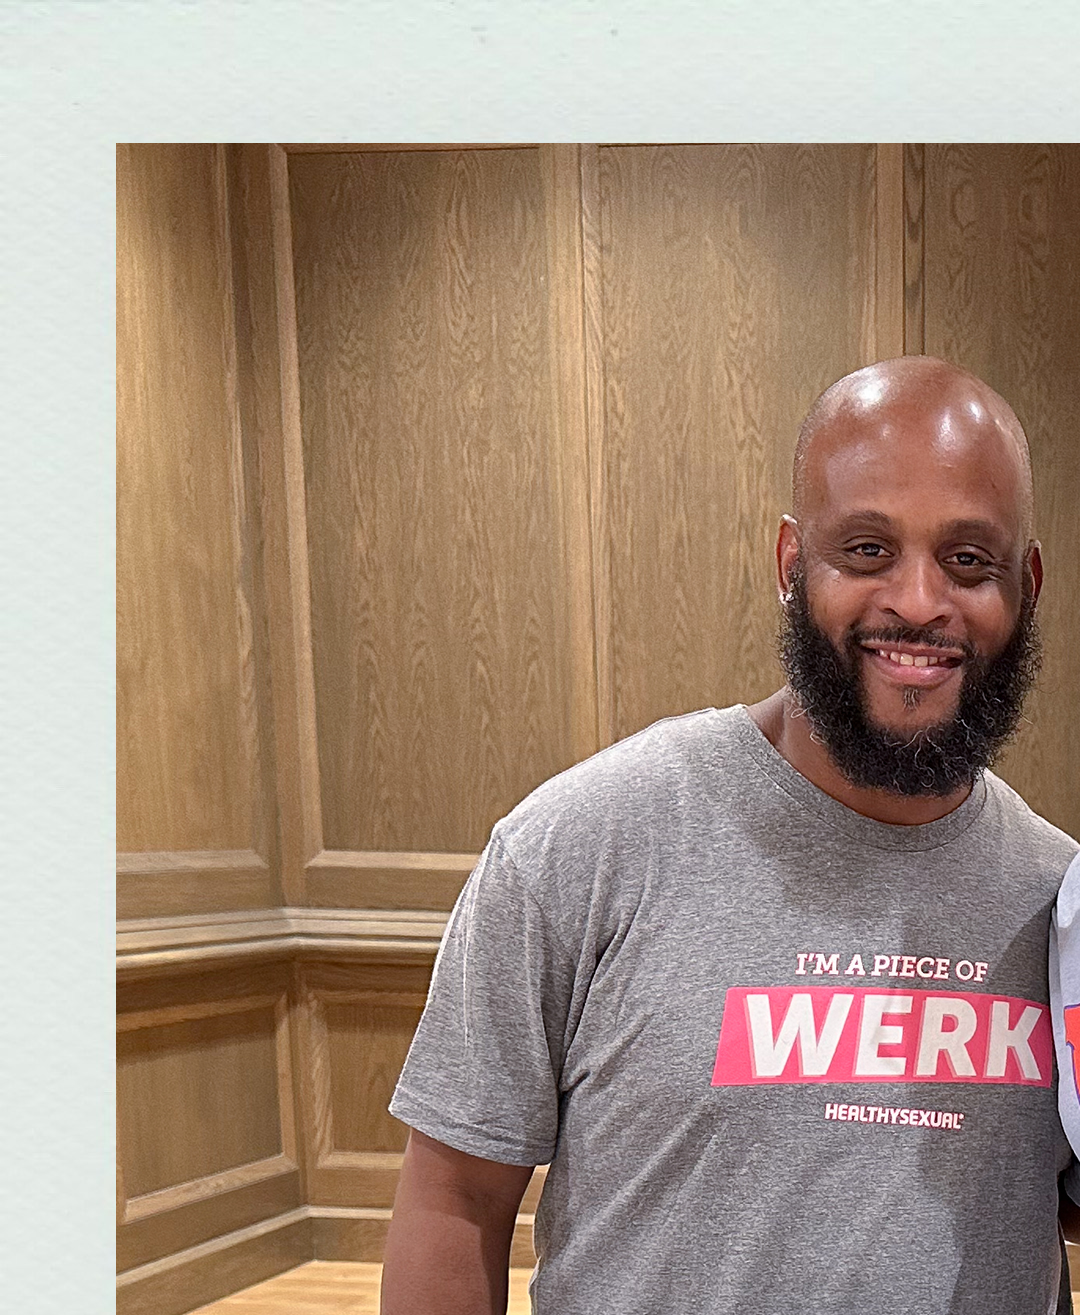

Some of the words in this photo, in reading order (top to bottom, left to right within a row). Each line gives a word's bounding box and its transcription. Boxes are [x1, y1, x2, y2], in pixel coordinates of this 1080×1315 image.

[795, 954, 840, 976] I'M
[844, 954, 866, 977] A
[872, 955, 950, 980] PIECE
[955, 960, 989, 982] OF
[743, 994, 1043, 1080] WERK
